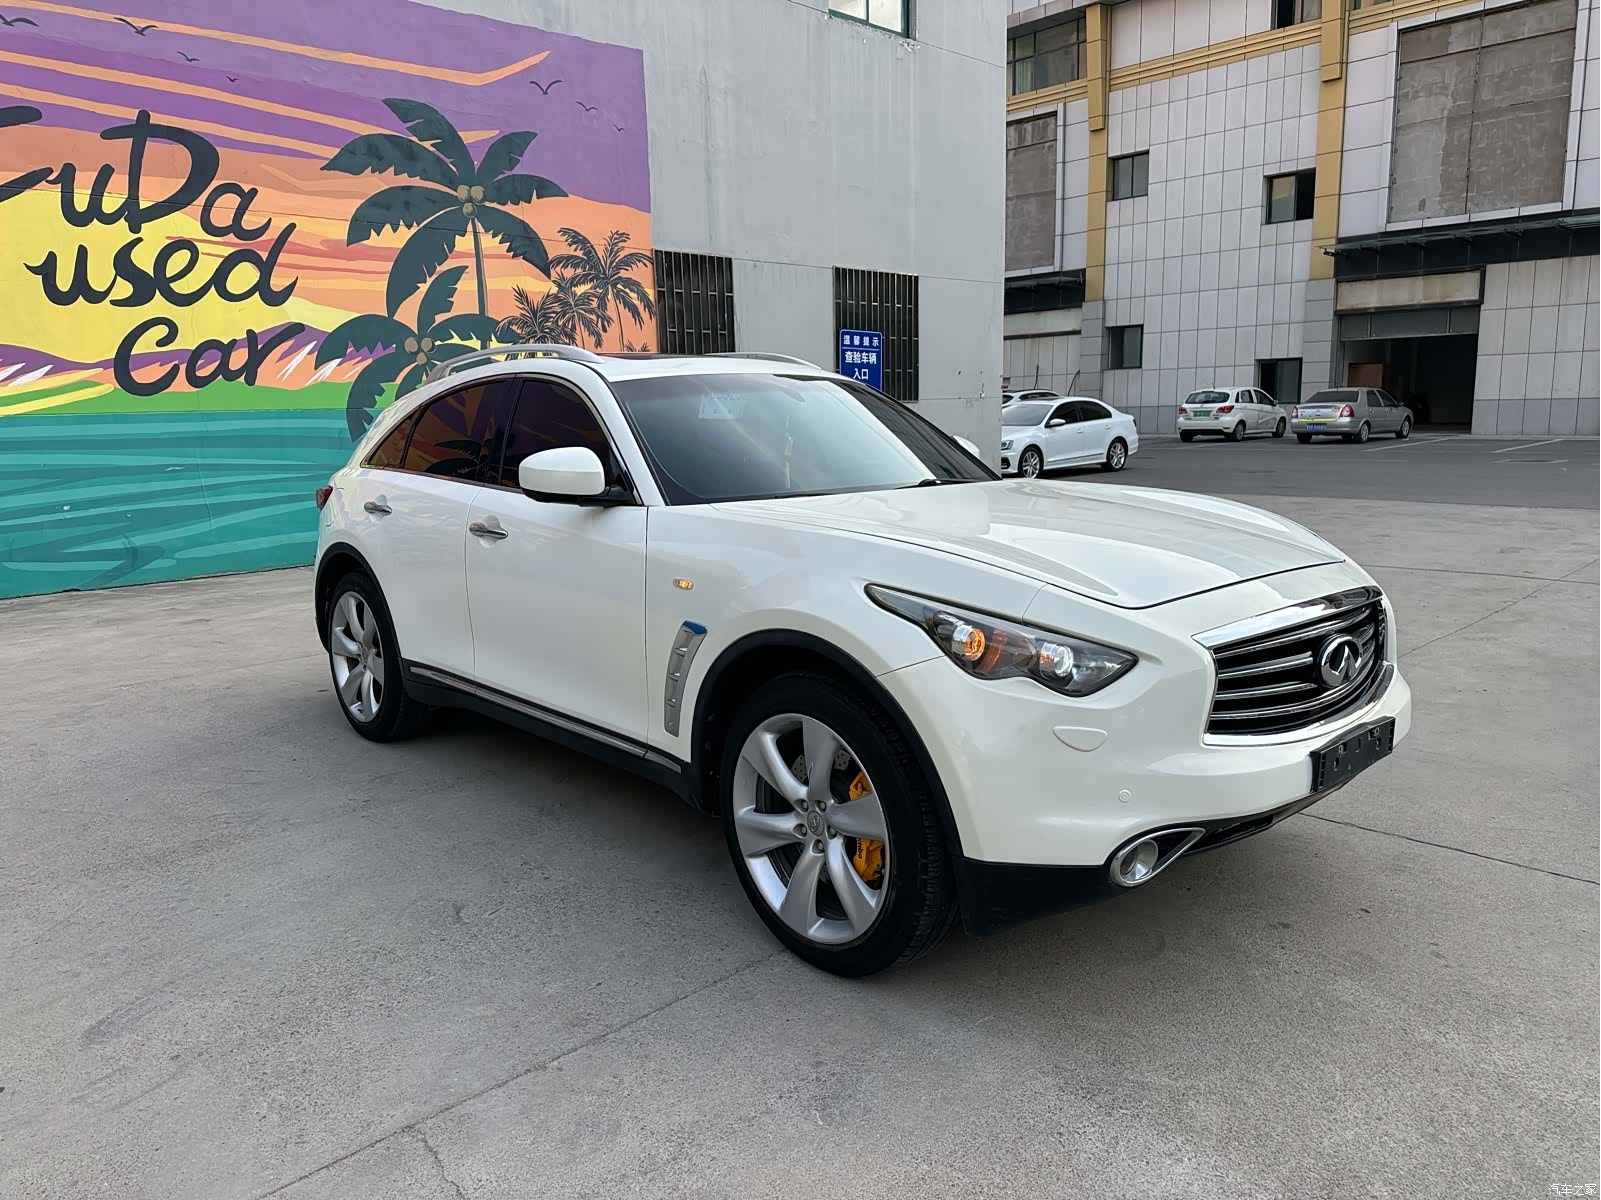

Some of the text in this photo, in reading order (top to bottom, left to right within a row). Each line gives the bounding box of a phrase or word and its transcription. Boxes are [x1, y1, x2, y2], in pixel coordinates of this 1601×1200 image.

[0, 105, 272, 241] uDa
[23, 222, 299, 307] used
[113, 316, 306, 397] Car
[843, 335, 879, 347] 温馨提示
[844, 351, 877, 365] 查验车辆
[853, 368, 869, 380] 入口
